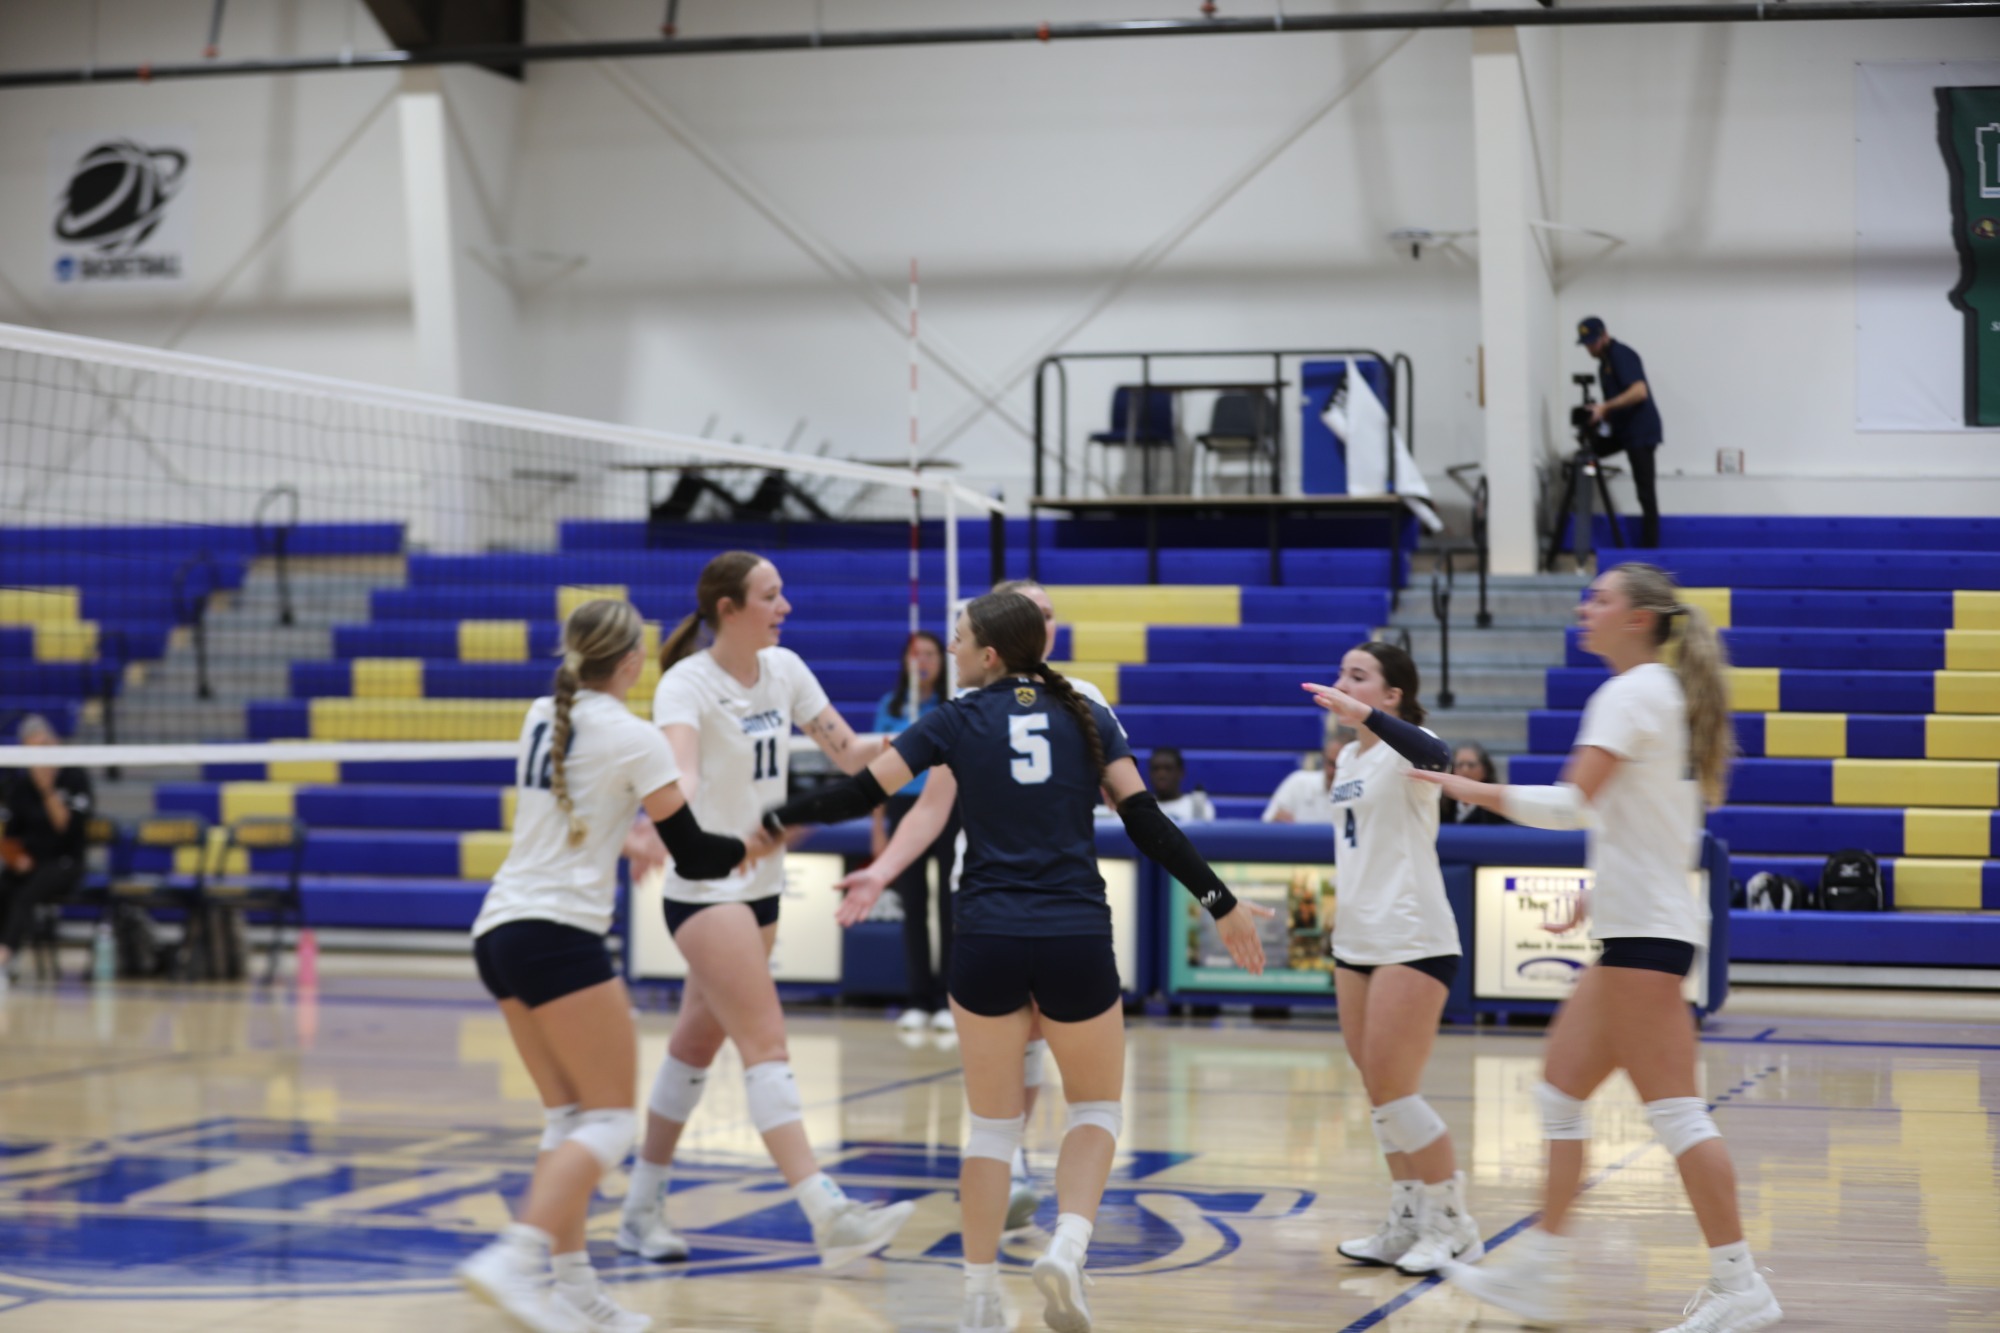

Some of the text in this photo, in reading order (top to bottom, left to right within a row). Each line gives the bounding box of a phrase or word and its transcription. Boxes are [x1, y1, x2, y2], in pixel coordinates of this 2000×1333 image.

[753, 737, 778, 781] 11
[1008, 712, 1052, 784] 5
[1344, 807, 1357, 848] 4
